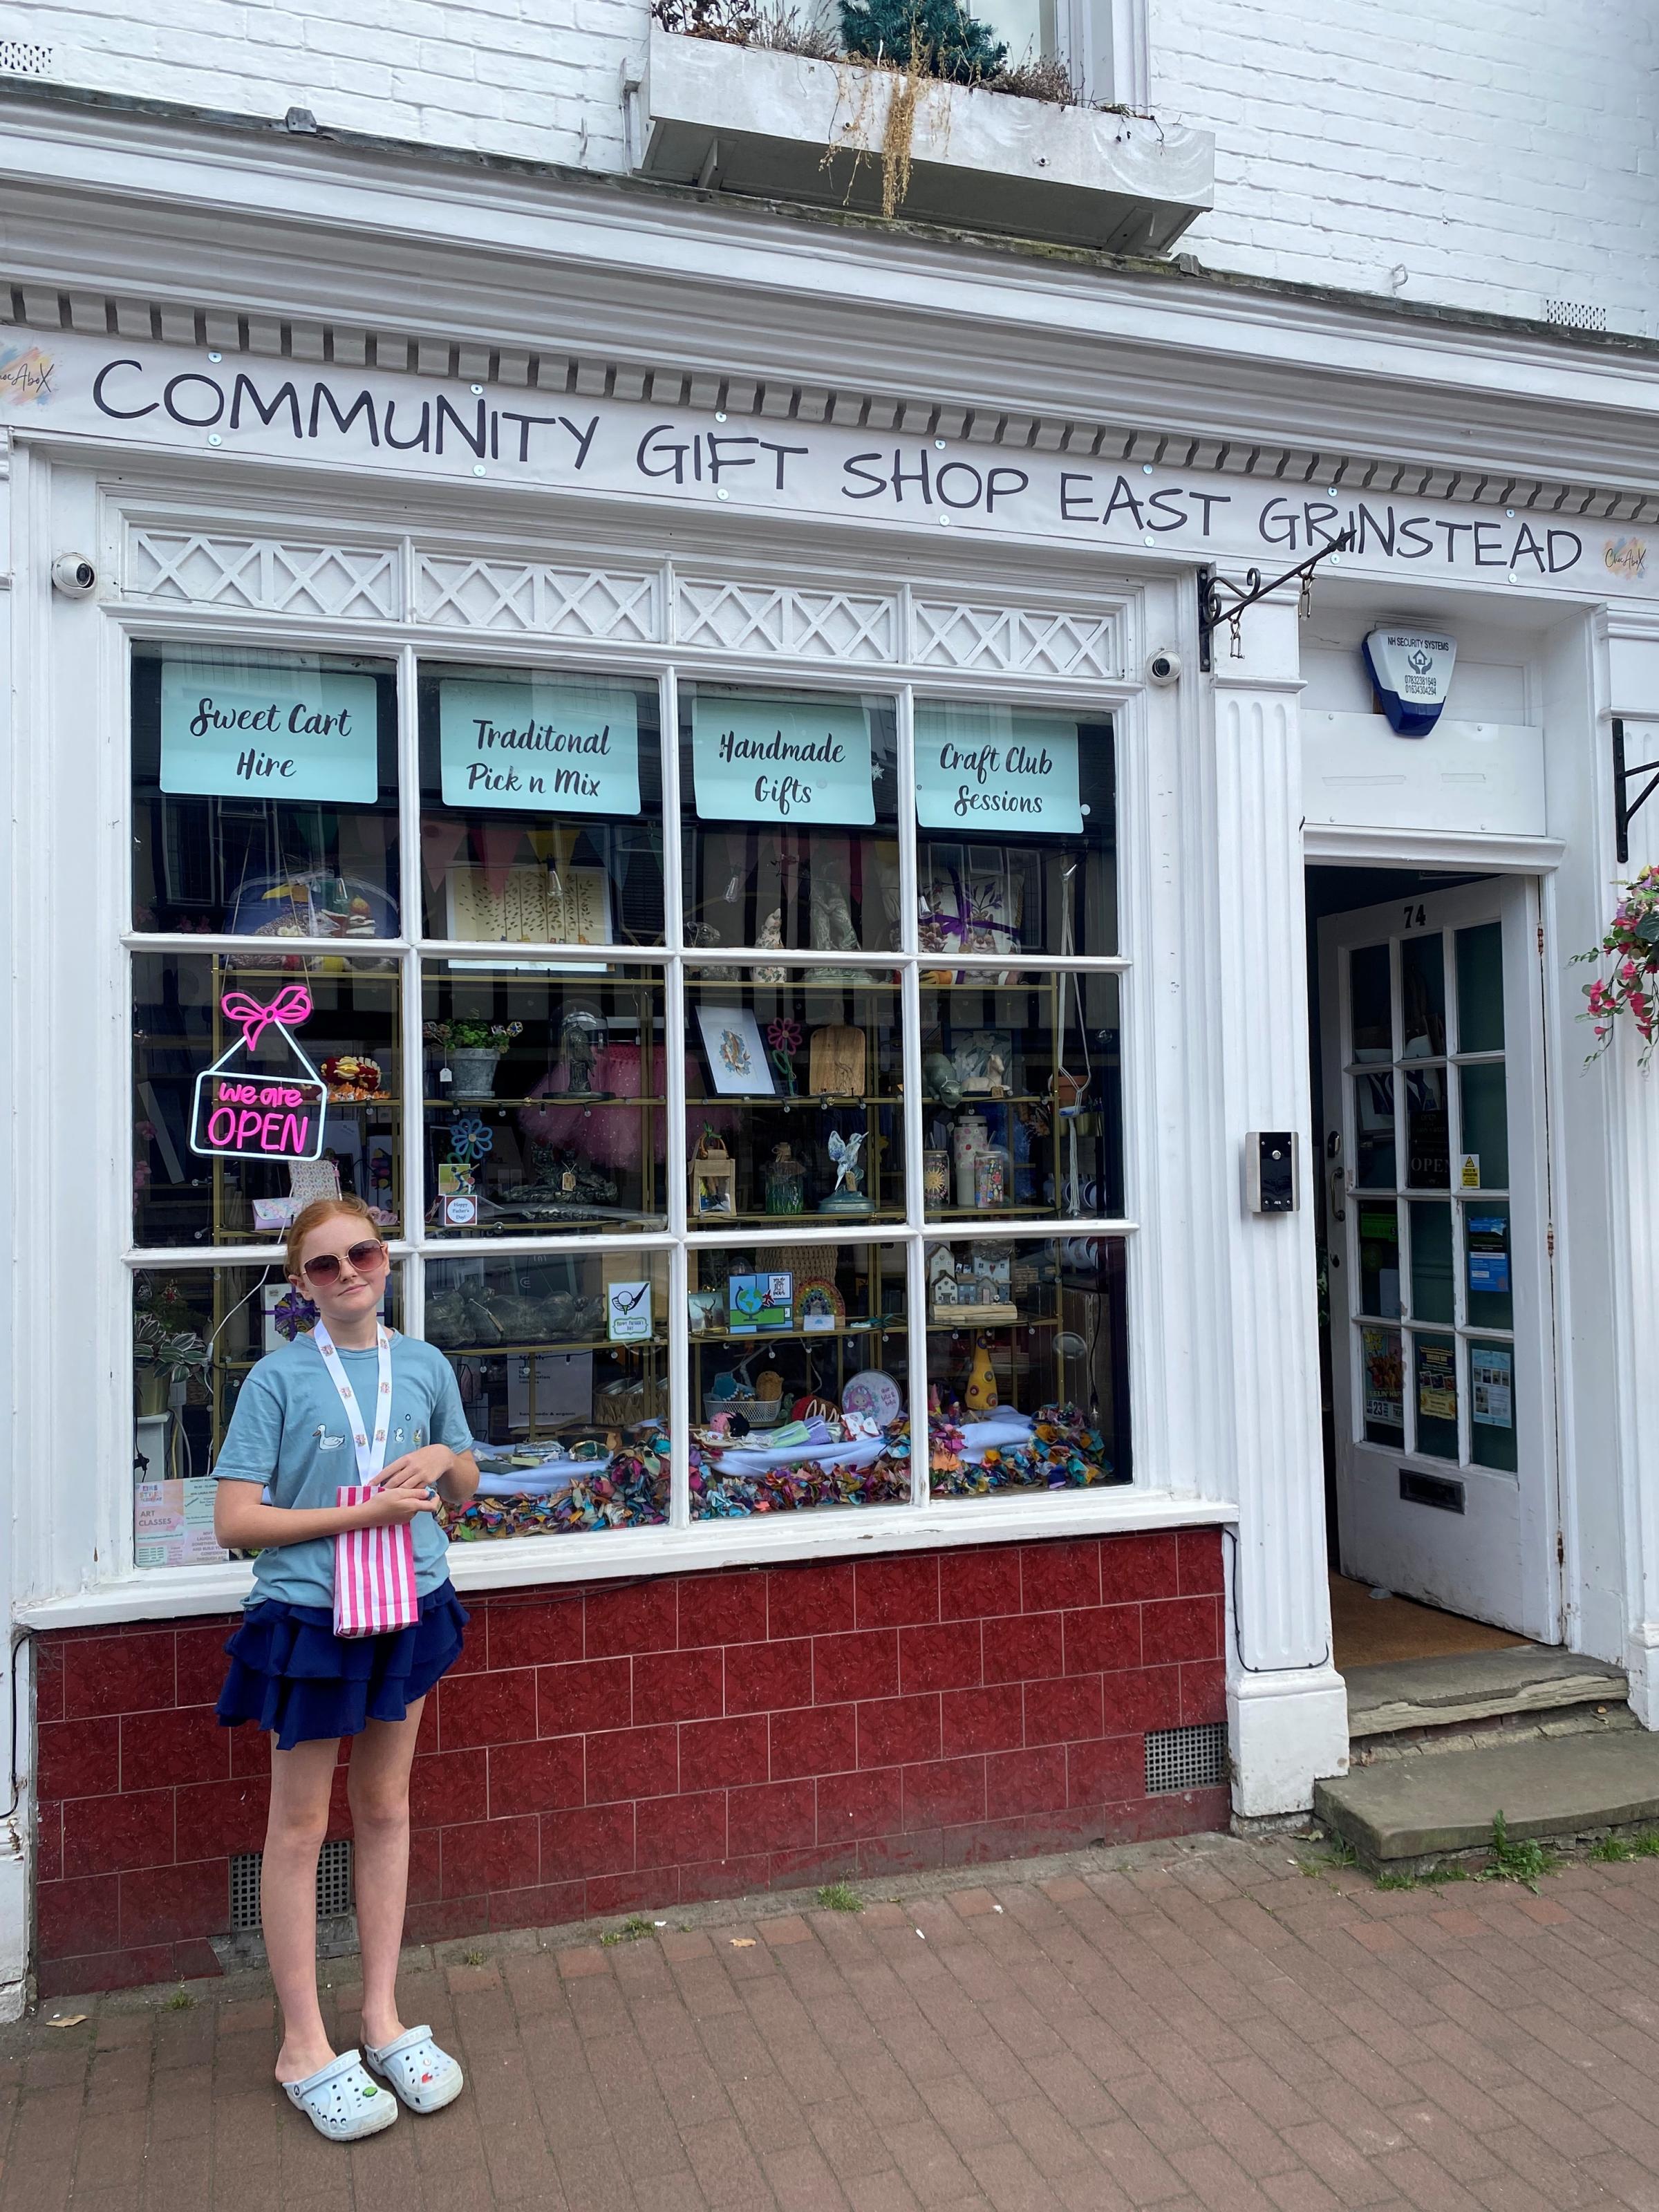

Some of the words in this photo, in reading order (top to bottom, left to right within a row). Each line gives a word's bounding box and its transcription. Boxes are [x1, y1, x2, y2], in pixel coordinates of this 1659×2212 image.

[0, 363, 55, 393] ocAboX
[93, 359, 600, 471] COMMUNITY
[636, 424, 809, 491] GIFT
[841, 448, 1029, 514] SHOP
[1060, 471, 1232, 536] EAST
[1258, 496, 1583, 574] GRINSTEAD
[1387, 636, 1396, 646] NH
[1396, 637, 1424, 648] SECURITY
[1424, 640, 1450, 651] SYSTEMS
[189, 697, 281, 738] Sweet
[288, 703, 353, 738] Cart
[472, 719, 612, 756] Traditonal
[719, 730, 846, 764] Handmade
[236, 748, 297, 781] Hire
[465, 762, 523, 792] Pick
[529, 776, 547, 794] n
[554, 768, 601, 797] Mix
[939, 742, 1001, 785] Craft
[1005, 746, 1053, 776] Club
[754, 775, 812, 815] Gifts
[953, 785, 1043, 816] Sessions
[1403, 904, 1426, 929] 74
[219, 1082, 256, 1105] we
[257, 1085, 303, 1107] are
[208, 1107, 308, 1154] OPEN
[1373, 1401, 1382, 1416] 23
[138, 1518, 171, 1526] CLASSES
